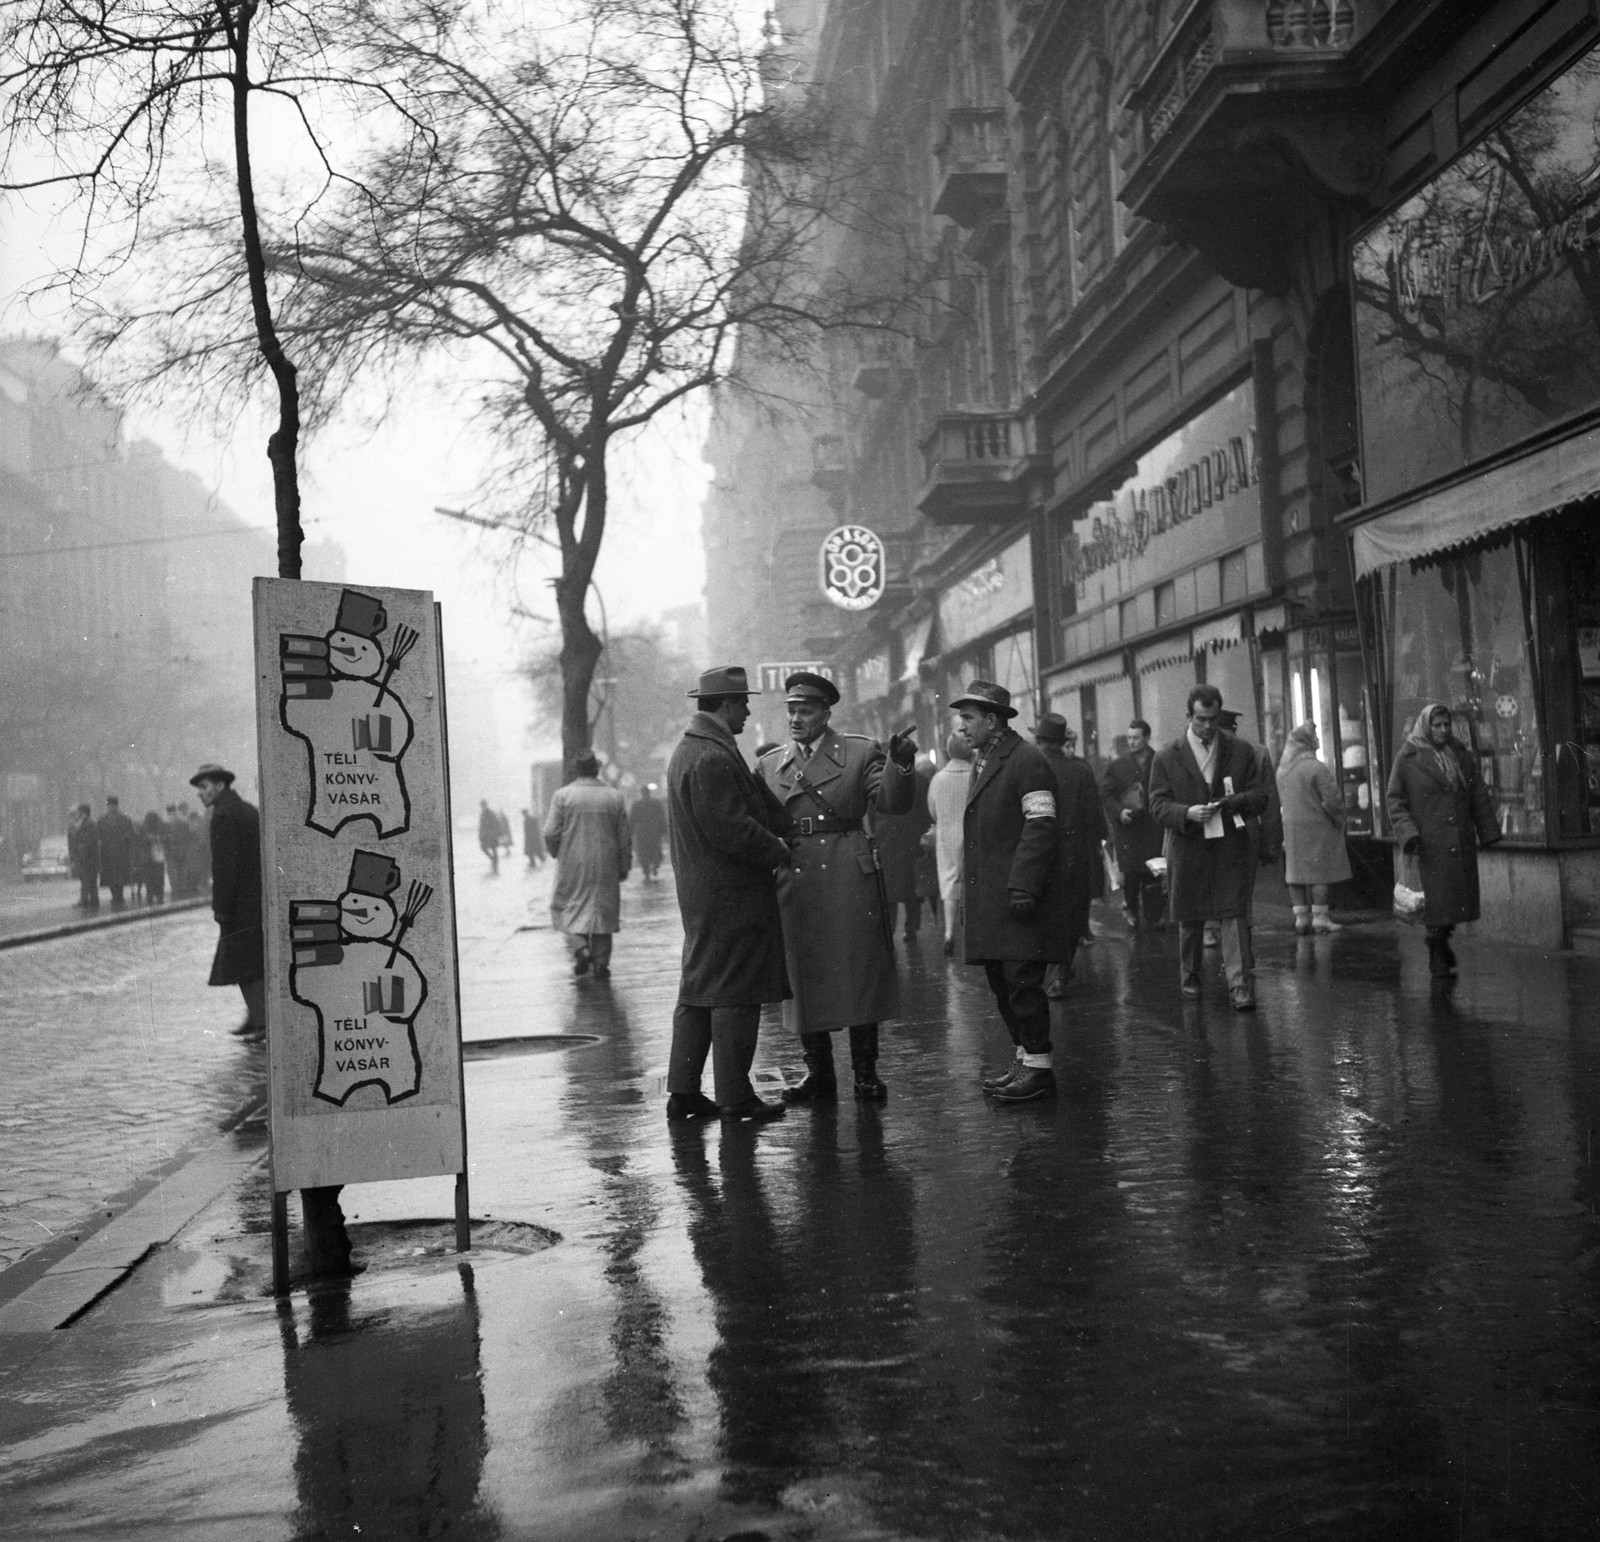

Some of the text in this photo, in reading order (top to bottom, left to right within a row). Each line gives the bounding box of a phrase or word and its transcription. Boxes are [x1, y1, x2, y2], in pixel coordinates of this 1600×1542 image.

[324, 751, 357, 765] TÉLI
[325, 771, 379, 785] KÖNYV-
[328, 791, 381, 805] VÁSÁR
[334, 1017, 367, 1031] TÉLI
[334, 1037, 389, 1052] KÖNYV-
[335, 1056, 390, 1072] VÁSÁR
